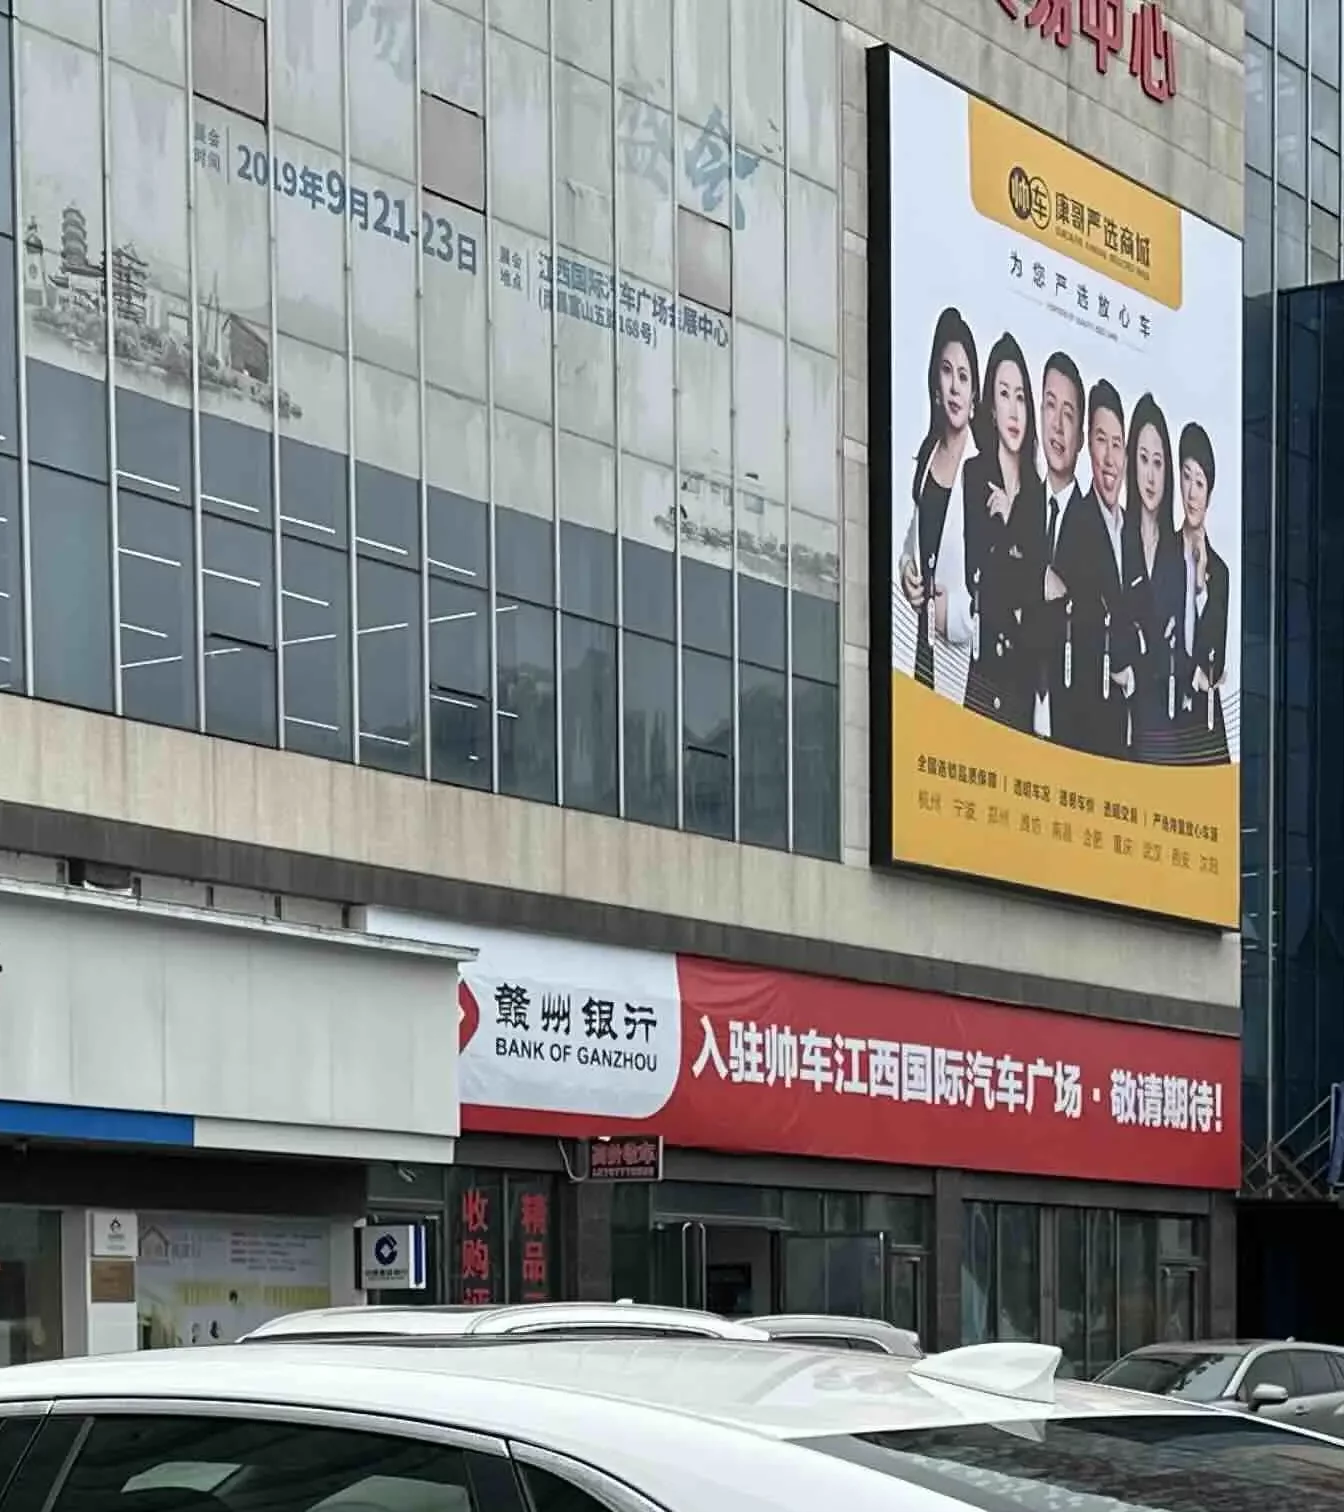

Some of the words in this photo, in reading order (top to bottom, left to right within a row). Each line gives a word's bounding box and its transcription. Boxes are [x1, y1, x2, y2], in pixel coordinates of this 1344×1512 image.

[996, 0, 1176, 103] 中心
[494, 983, 657, 1043] 赣州银行
[495, 1037, 545, 1061] BANK
[549, 1043, 572, 1063] OF
[577, 1046, 657, 1072] GANZHOU
[521, 1194, 548, 1302] 精品
